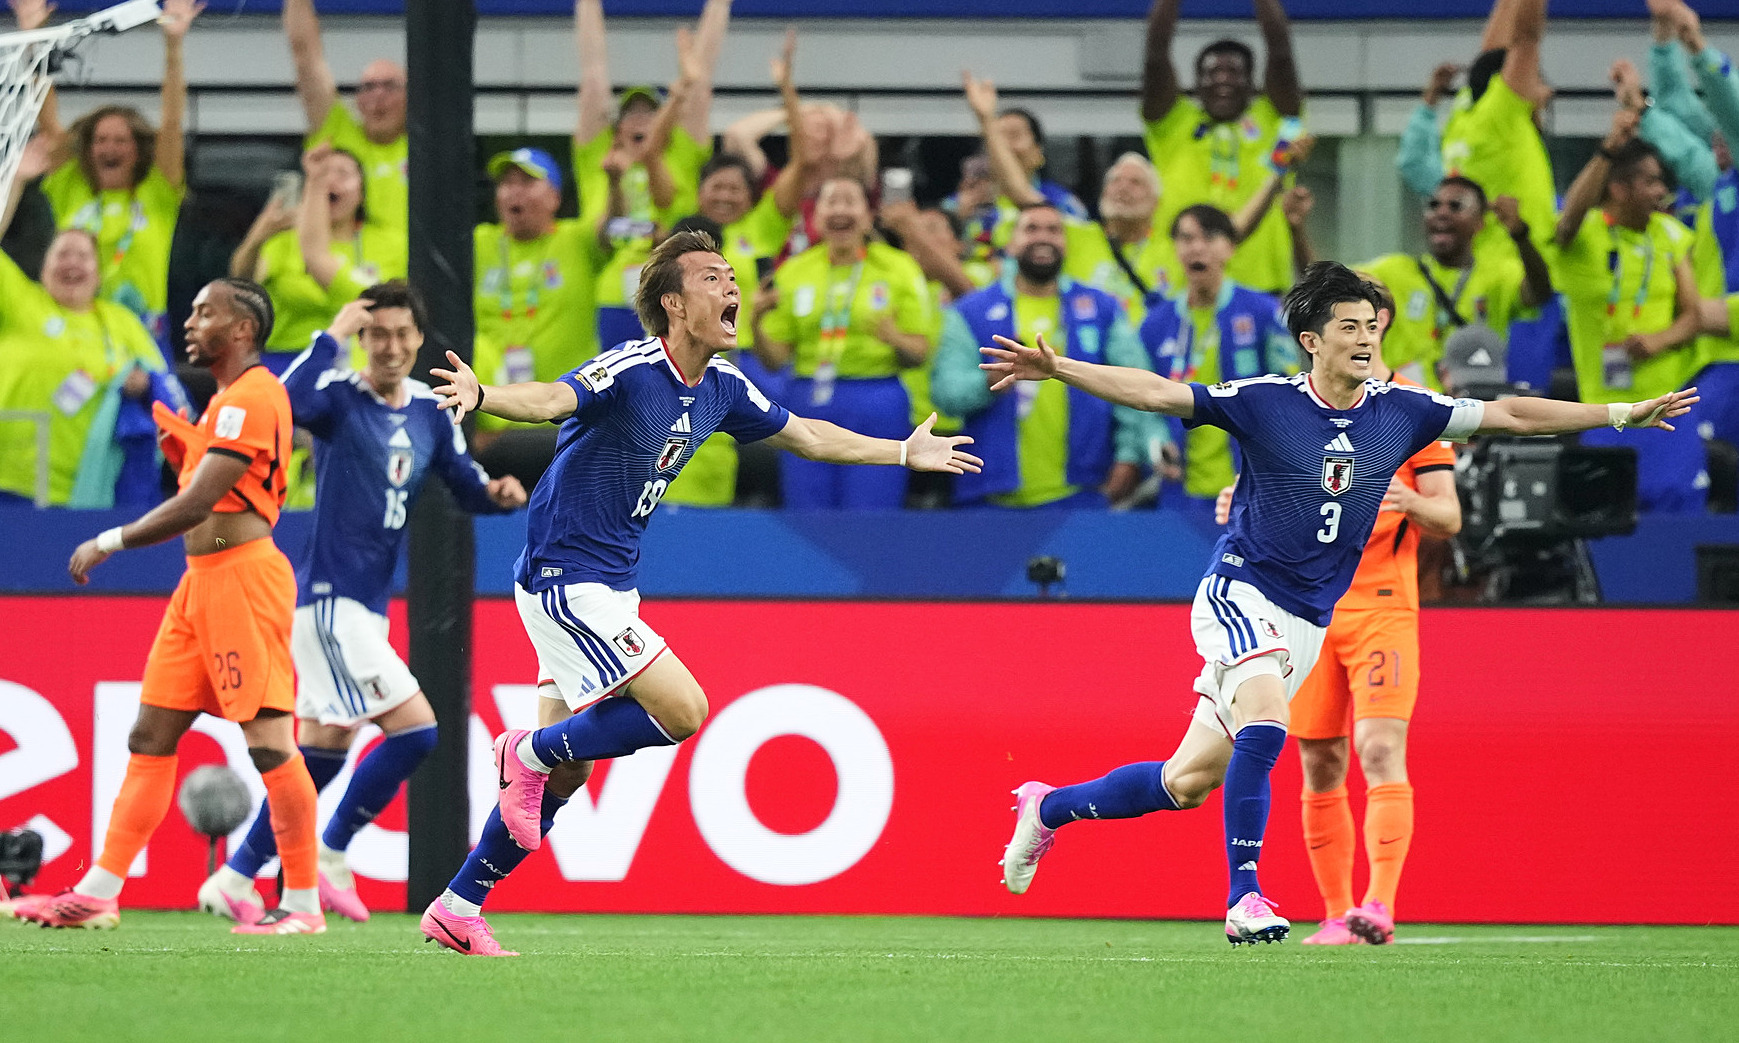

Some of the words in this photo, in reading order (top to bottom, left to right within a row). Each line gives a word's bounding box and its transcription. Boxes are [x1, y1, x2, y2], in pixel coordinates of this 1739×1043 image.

[383, 487, 408, 530] 15
[631, 479, 667, 517] 19
[1317, 501, 1342, 544] 3
[215, 651, 242, 690] 26
[1368, 650, 1400, 687] 21
